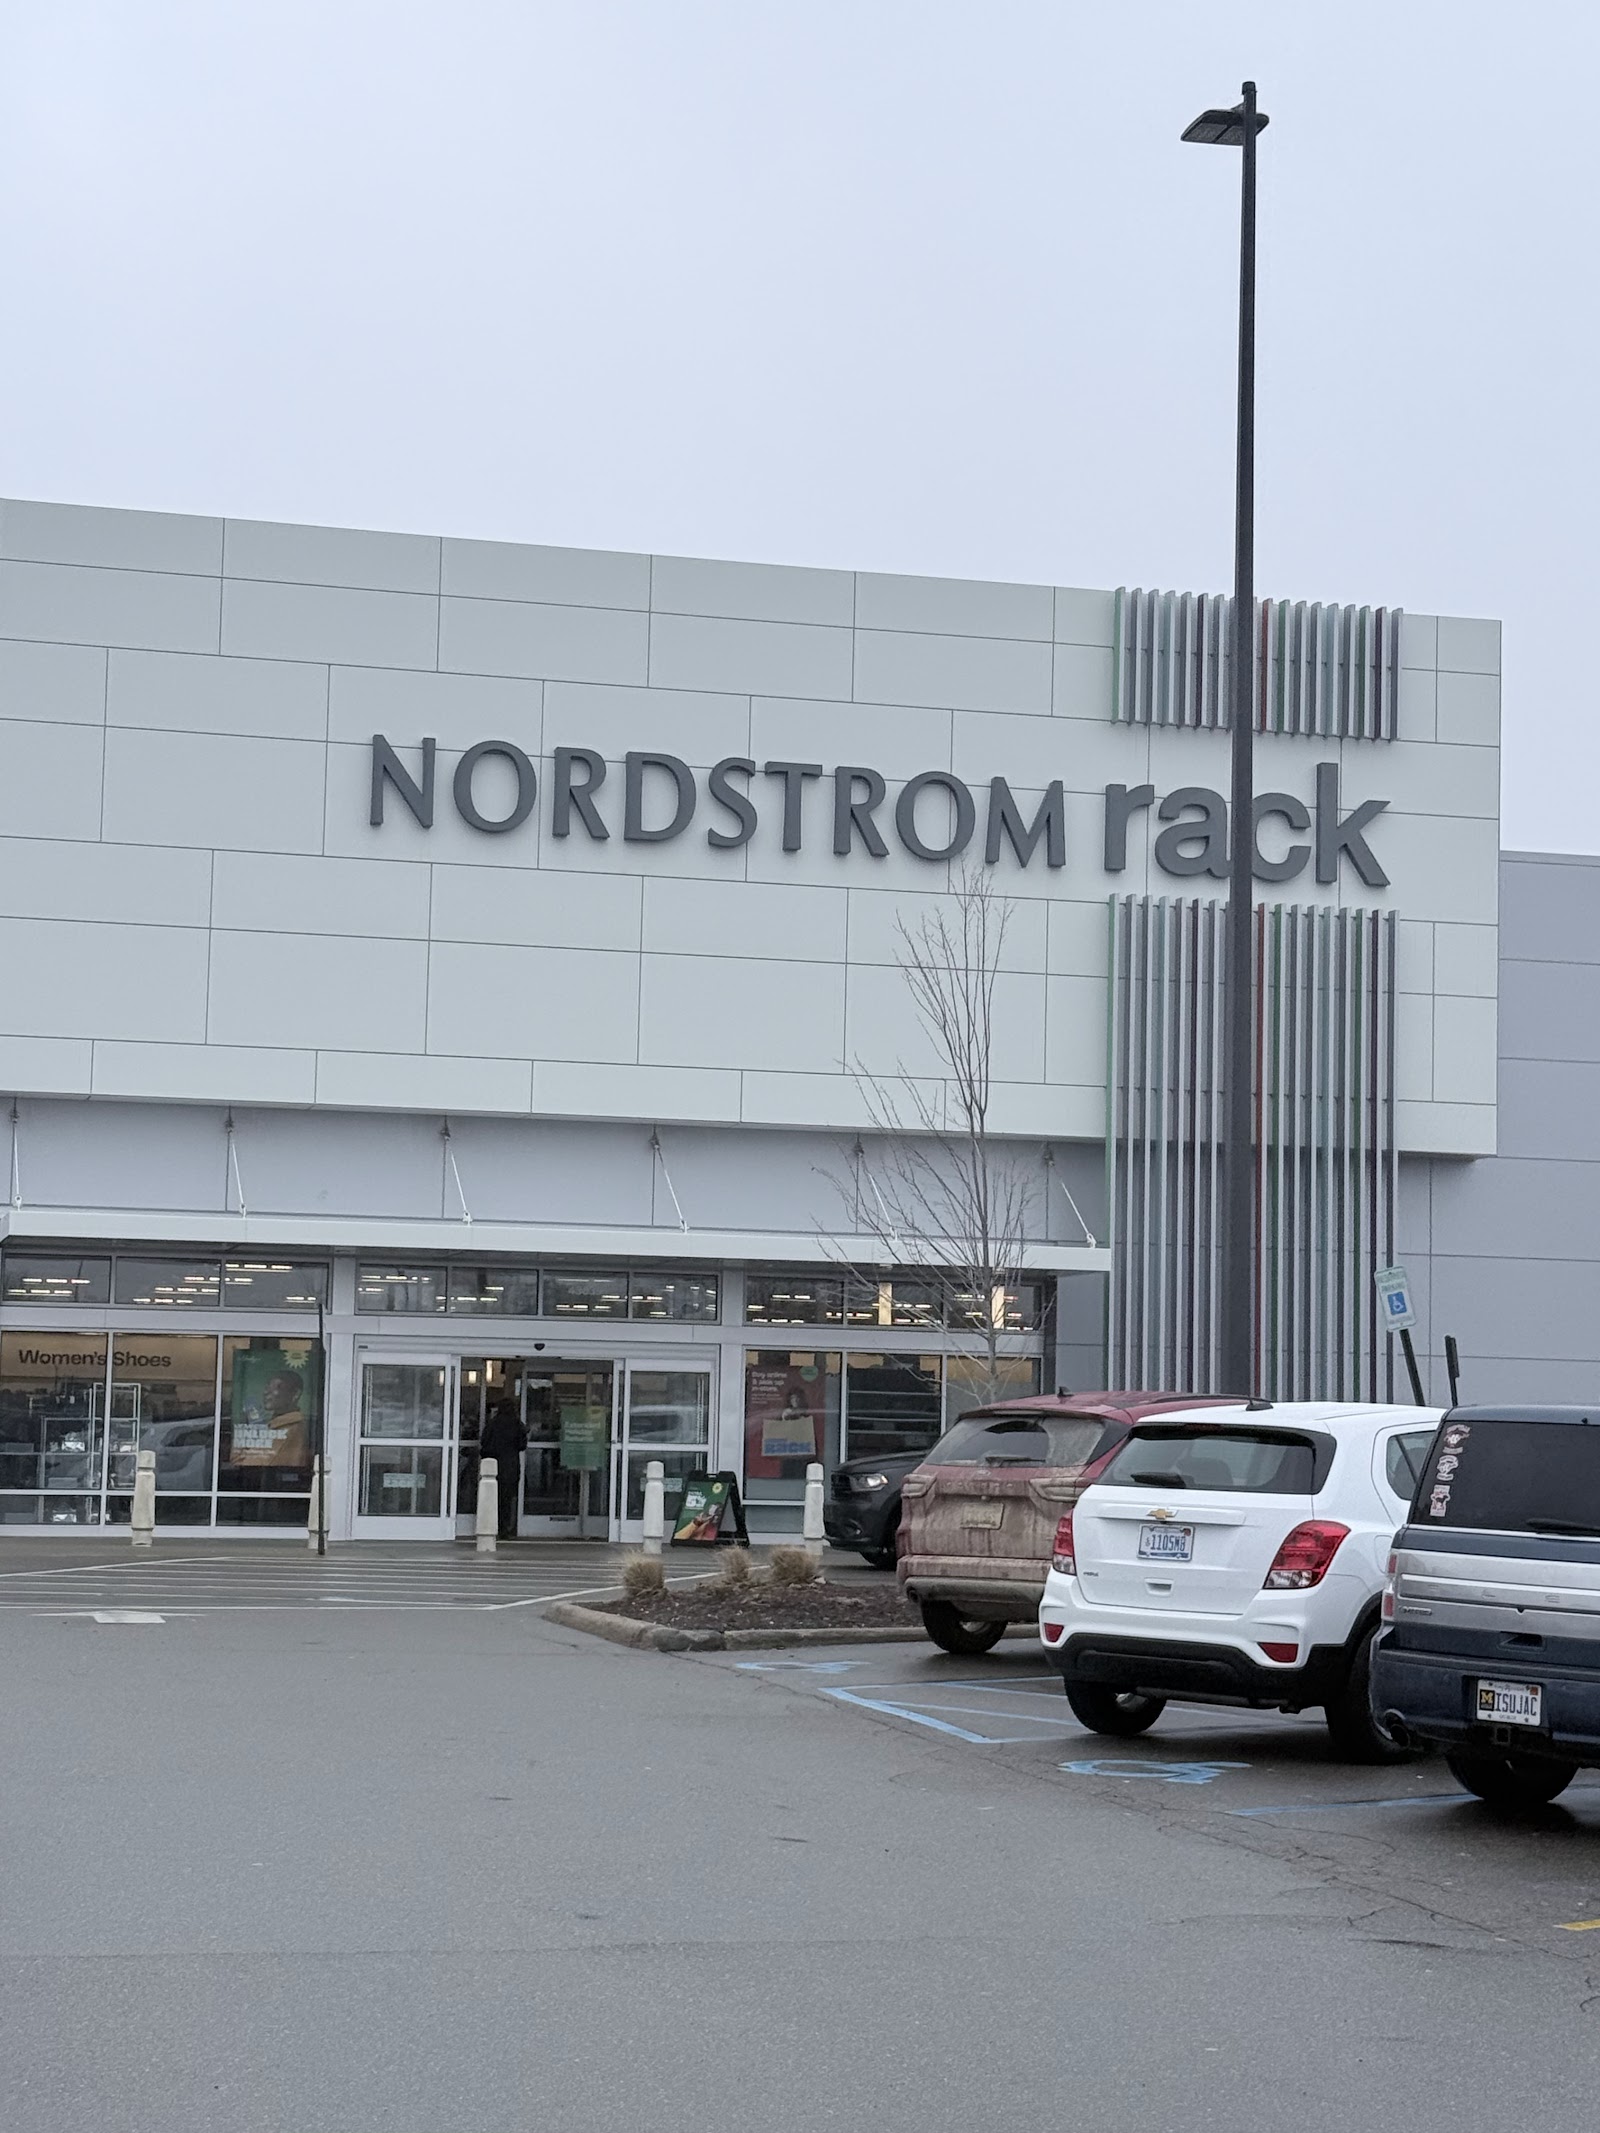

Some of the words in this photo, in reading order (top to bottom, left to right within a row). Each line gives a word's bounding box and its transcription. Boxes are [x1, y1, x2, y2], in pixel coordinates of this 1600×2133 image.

[370, 734, 1066, 867] NORDSTROM
[1104, 762, 1391, 886] rack
[18, 1349, 106, 1365] Women's
[113, 1351, 172, 1367] Shoes
